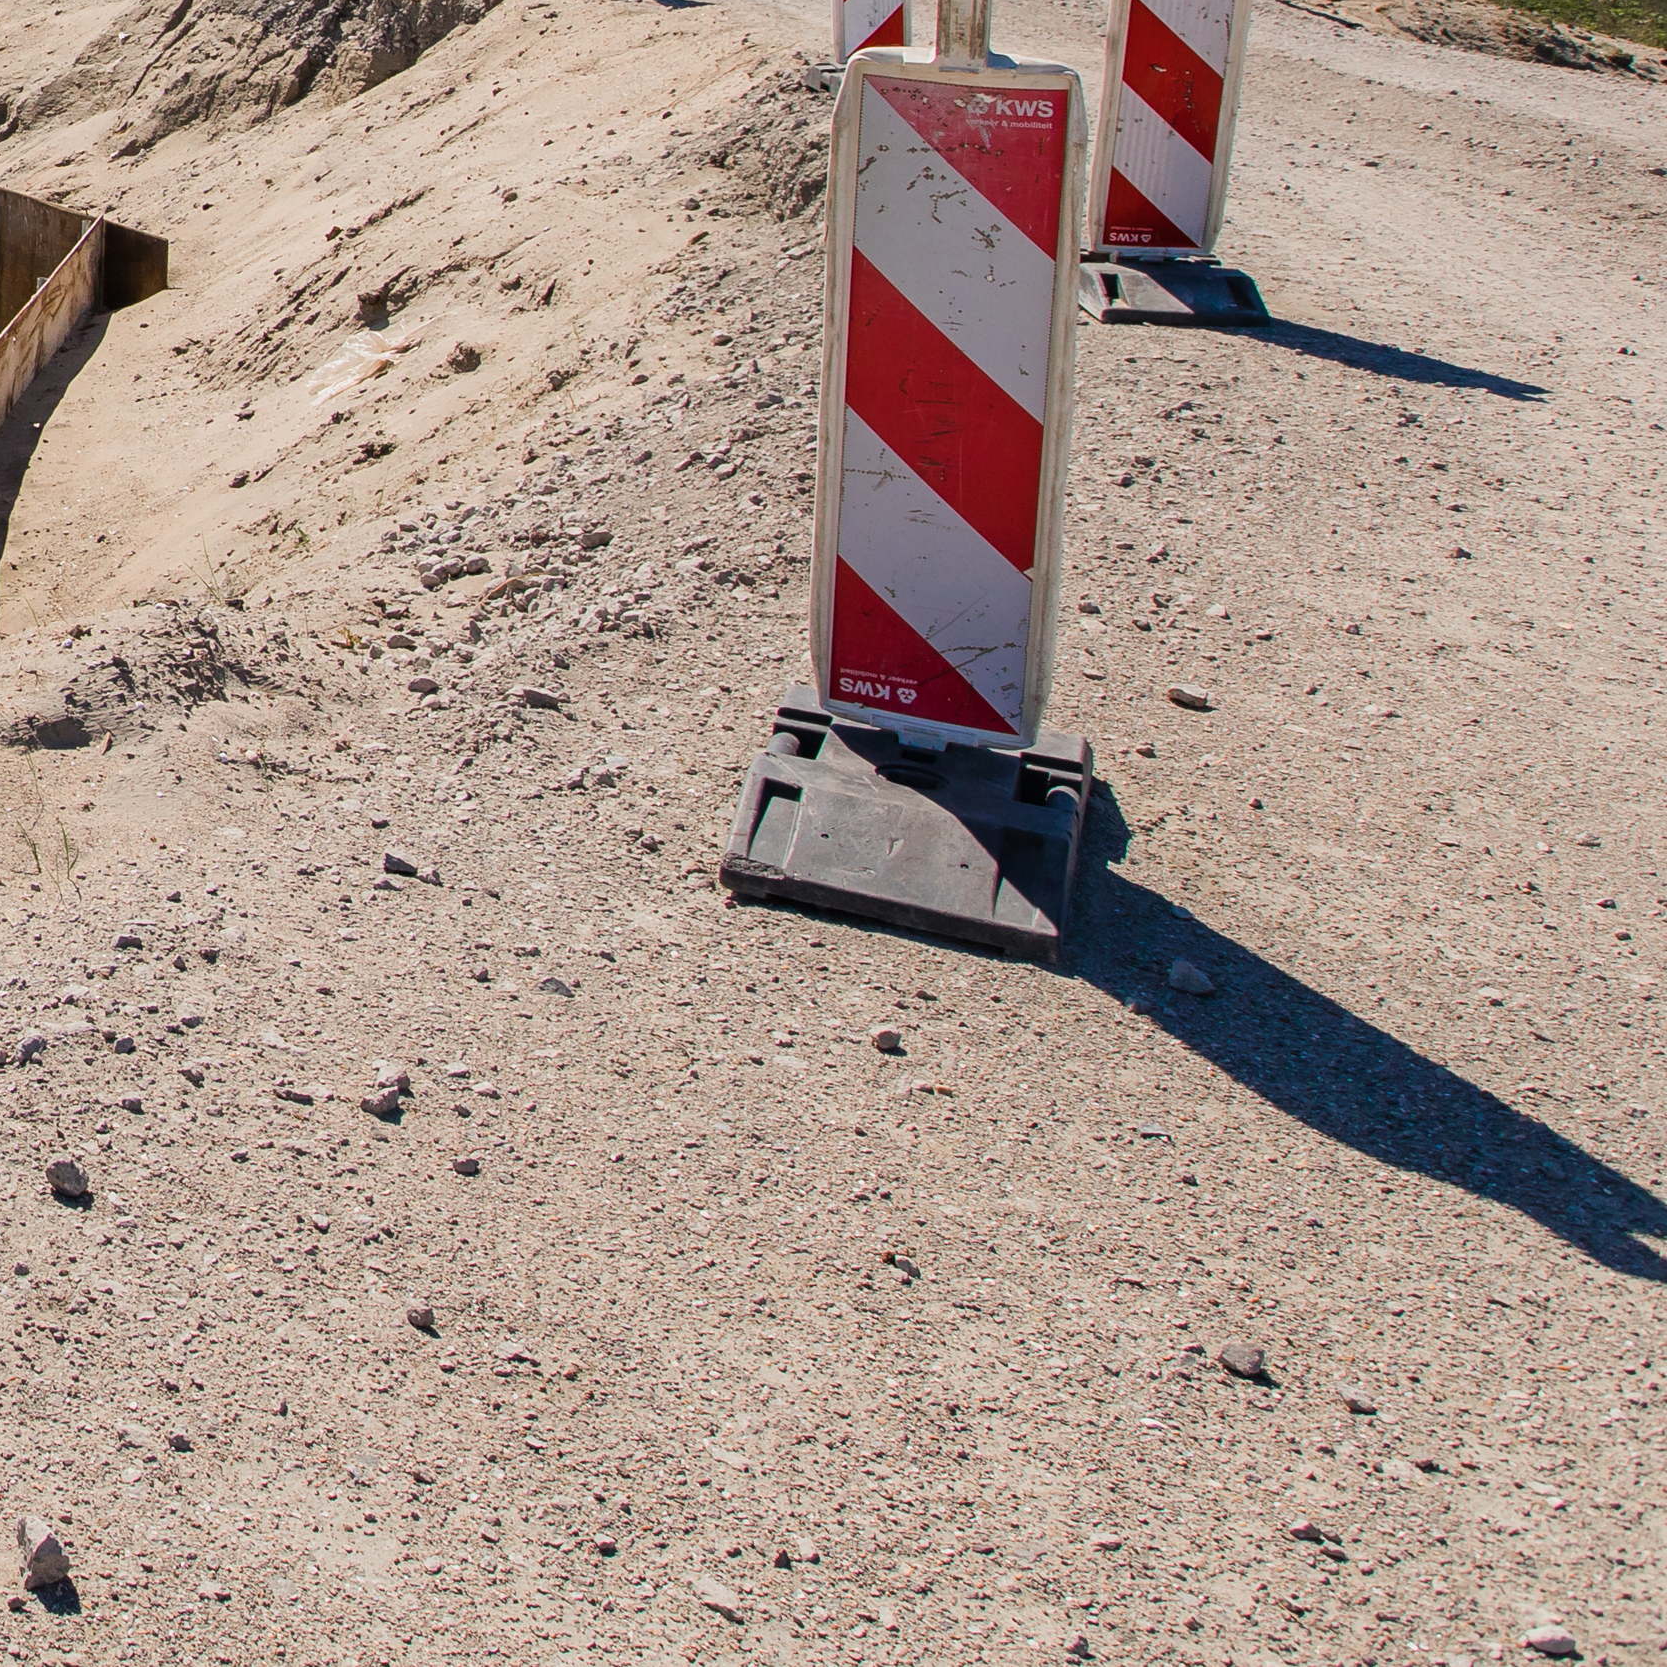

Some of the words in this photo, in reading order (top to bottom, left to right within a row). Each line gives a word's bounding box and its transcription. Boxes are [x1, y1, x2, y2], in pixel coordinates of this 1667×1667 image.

[995, 99, 1054, 118] KWS
[1001, 119, 1008, 127] &
[1010, 120, 1053, 129] mobiliteit
[1109, 232, 1139, 242] KWS
[840, 667, 878, 678] mobiliteit
[888, 675, 918, 685] verkeer
[839, 677, 891, 700] KWS
